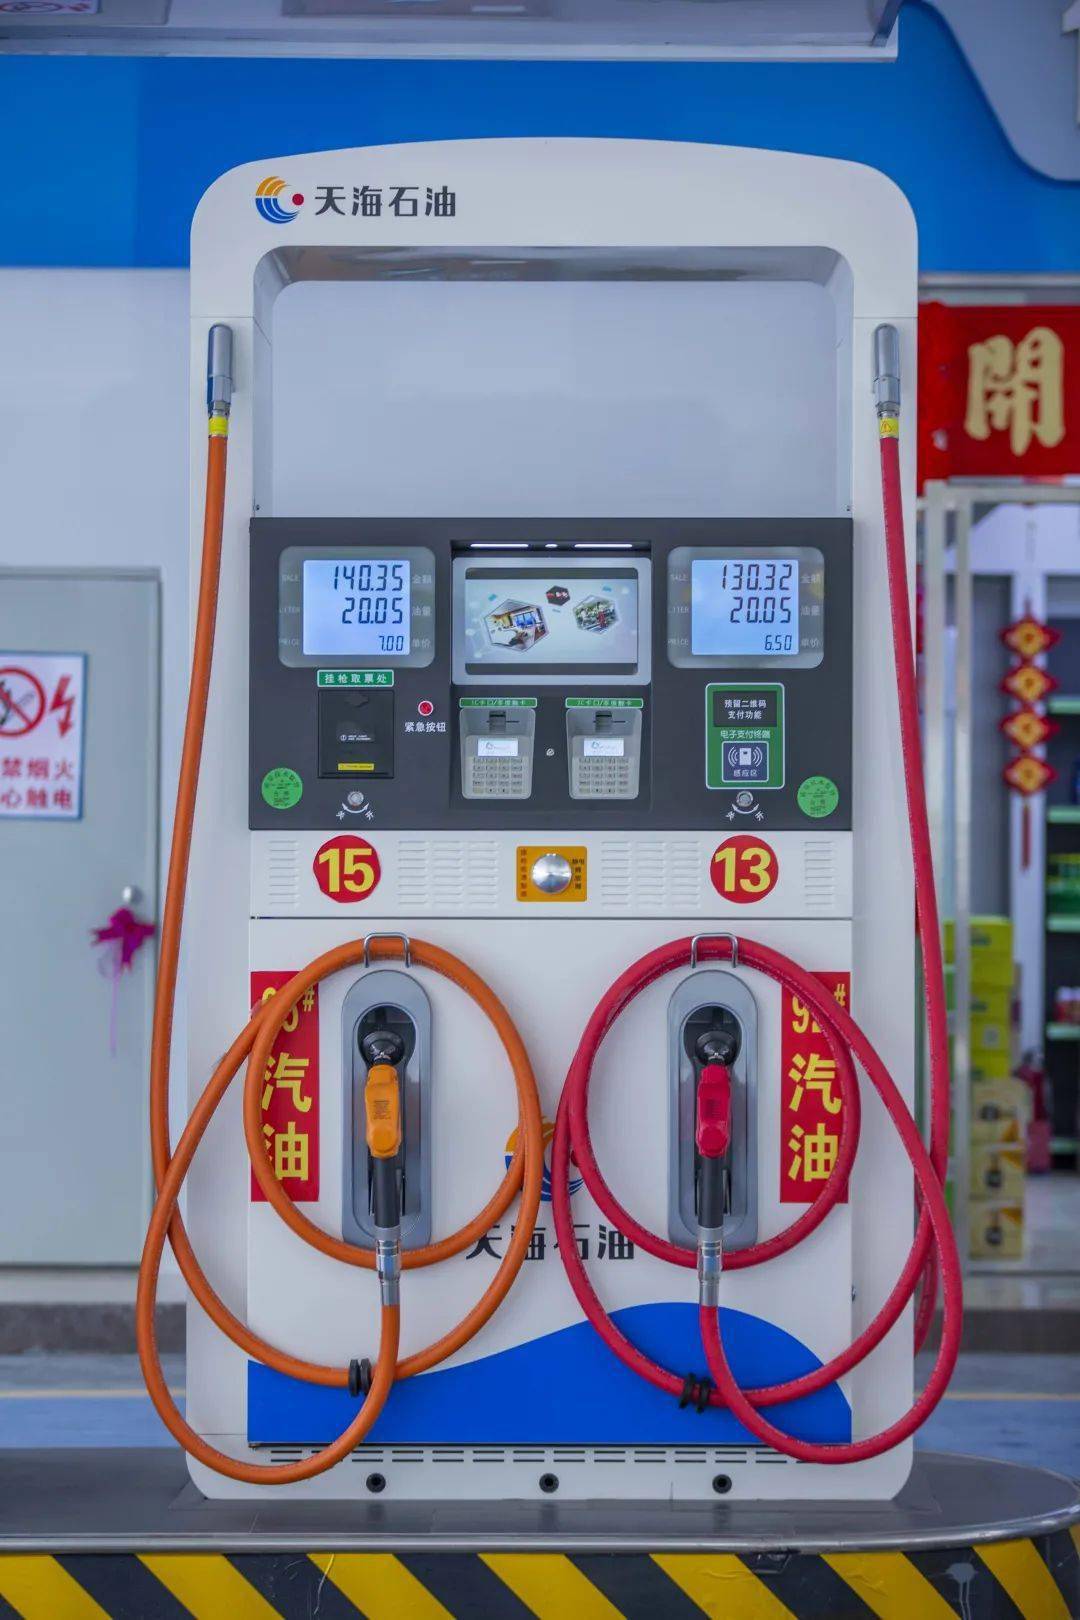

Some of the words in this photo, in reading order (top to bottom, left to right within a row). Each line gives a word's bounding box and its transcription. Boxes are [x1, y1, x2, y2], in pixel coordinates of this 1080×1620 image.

[315, 185, 456, 217] 天海石油
[334, 564, 403, 591] 140.35
[722, 564, 792, 591] 130.32
[341, 597, 403, 624] 20.05
[730, 597, 792, 623] 20.05
[378, 635, 404, 652] 7.00
[764, 634, 792, 651] 6.50
[325, 673, 387, 684] 挂枪取票处
[724, 699, 767, 709] 预留二维码
[727, 710, 762, 720] 支付功能
[404, 721, 447, 733] 紧急按钮
[720, 729, 771, 739] 电子支付终端
[733, 769, 758, 778] 感应区
[318, 847, 375, 894] 15
[714, 847, 772, 893] 13
[262, 1052, 313, 1181] 汽油
[788, 1053, 842, 1182] 汽油
